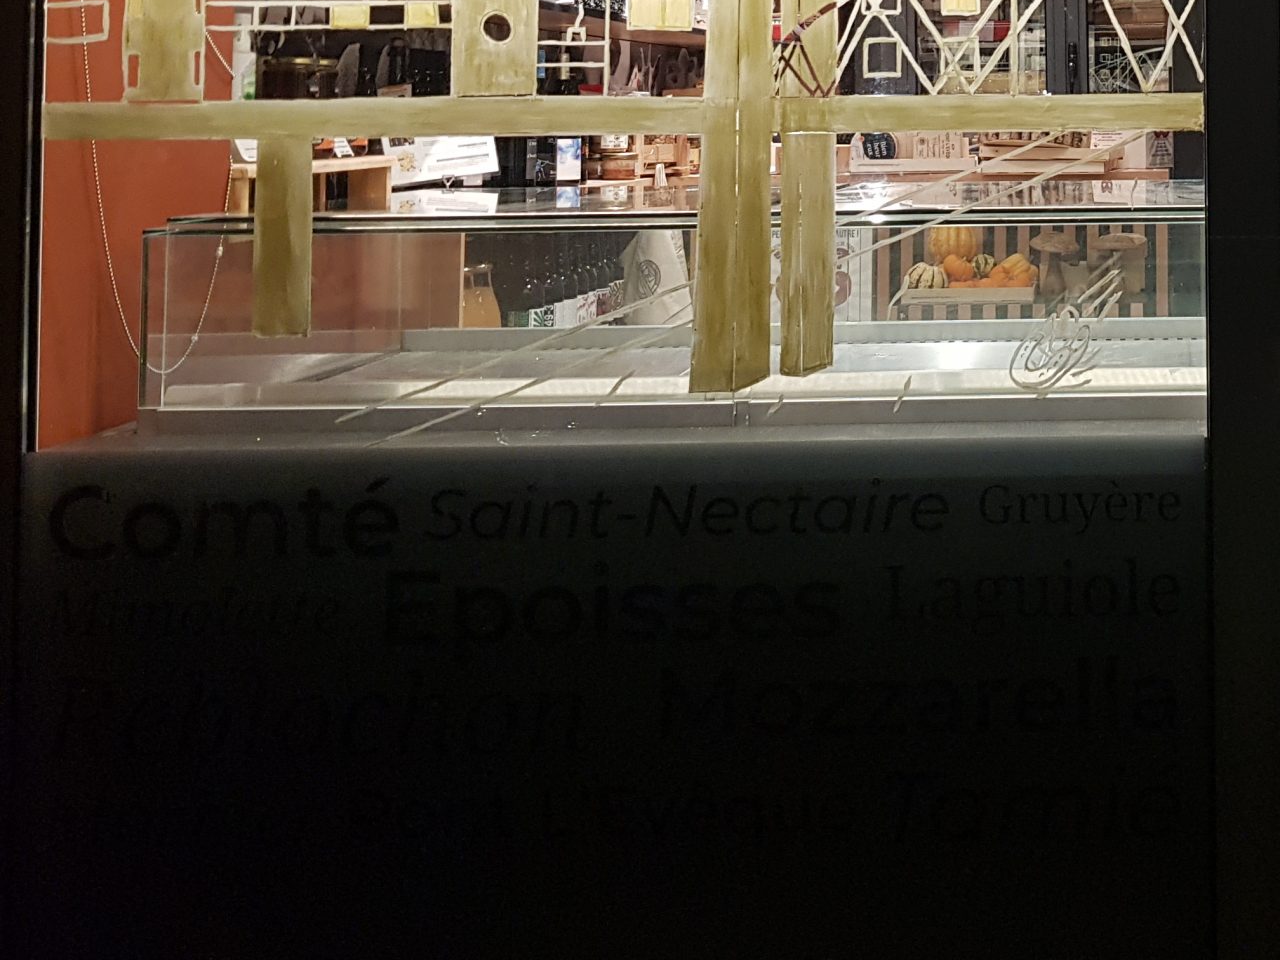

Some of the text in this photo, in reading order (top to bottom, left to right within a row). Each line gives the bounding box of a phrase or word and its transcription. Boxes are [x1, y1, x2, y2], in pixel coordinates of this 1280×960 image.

[48, 477, 1183, 560] Comté Saint-Nectaire Gruyère
[382, 559, 843, 666] Epoisses
[882, 554, 1183, 638] Laguiole
[657, 653, 1180, 741] Mozzarella
